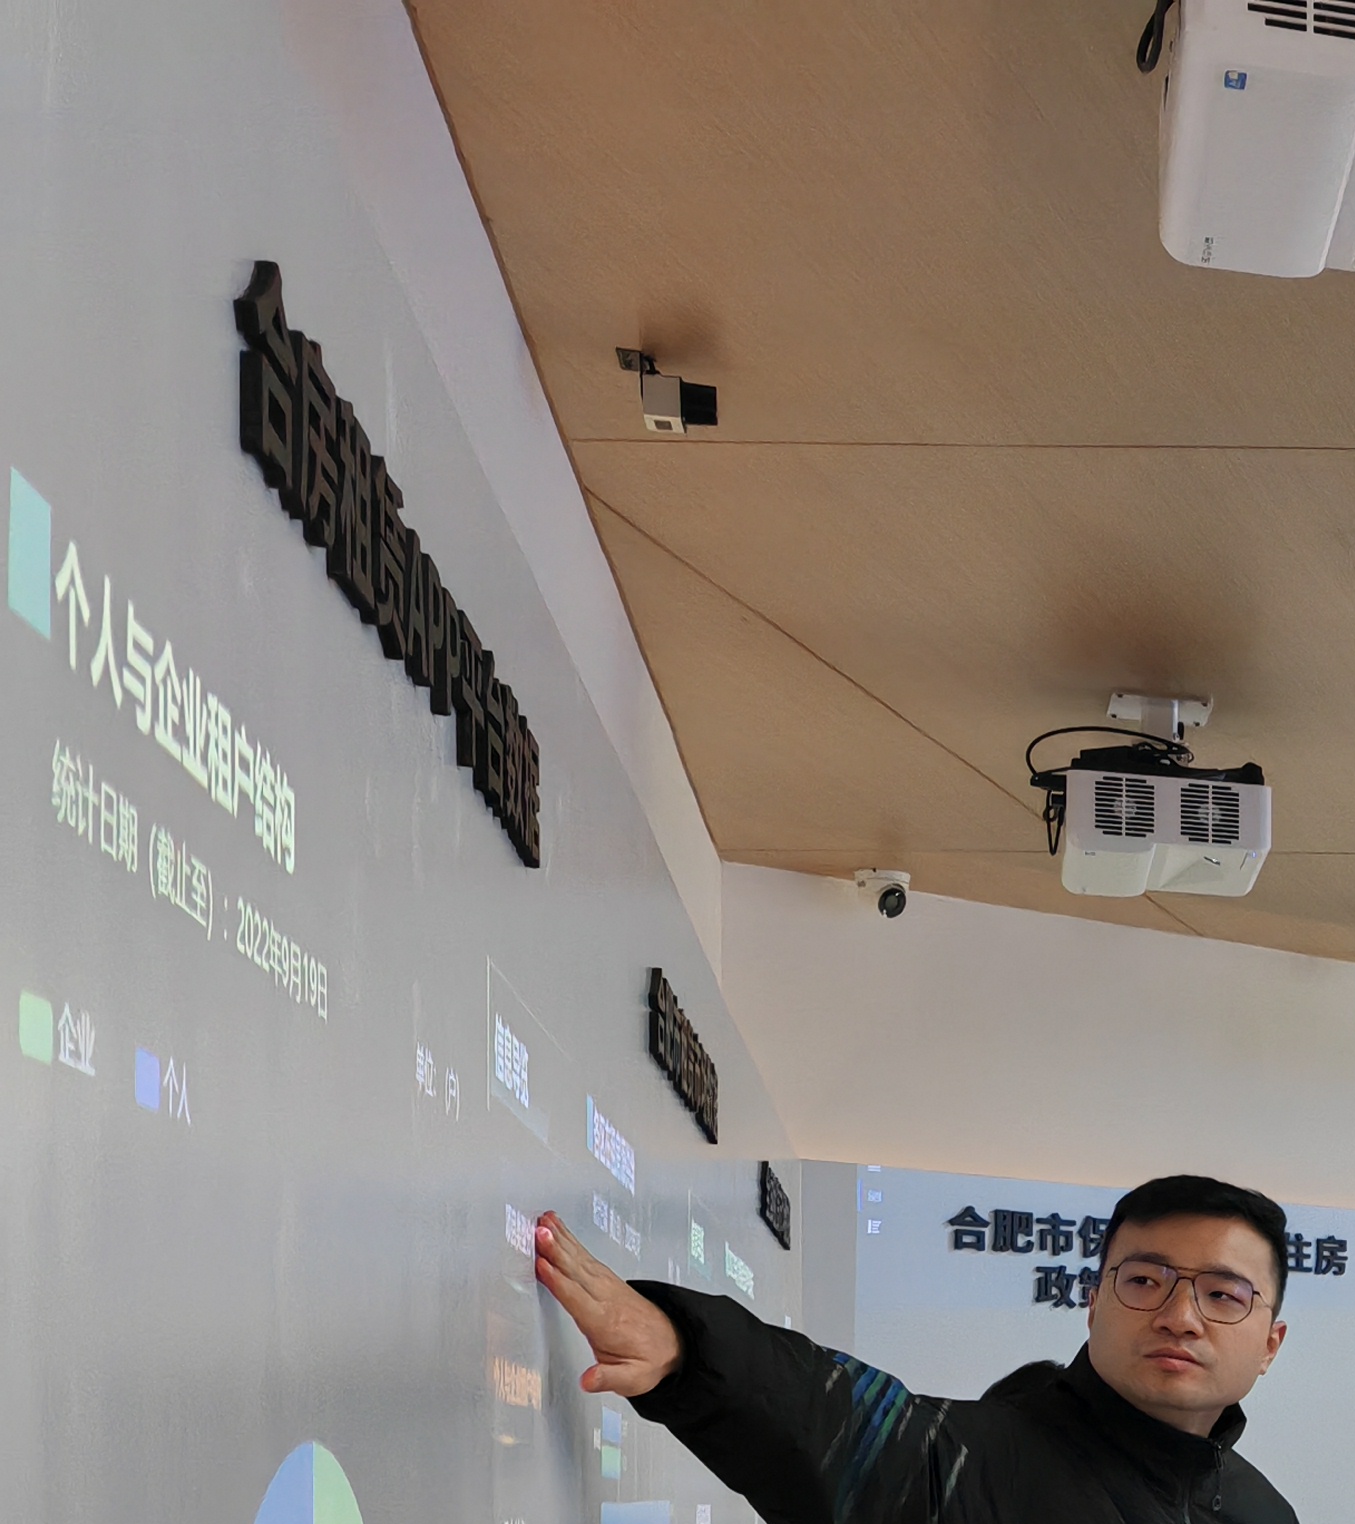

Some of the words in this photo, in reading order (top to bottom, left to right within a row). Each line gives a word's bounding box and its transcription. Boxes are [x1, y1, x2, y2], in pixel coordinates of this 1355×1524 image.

[55, 540, 295, 875] 个人与企业租户结构
[58, 1002, 96, 1076] 企业
[163, 1056, 191, 1126] 个人
